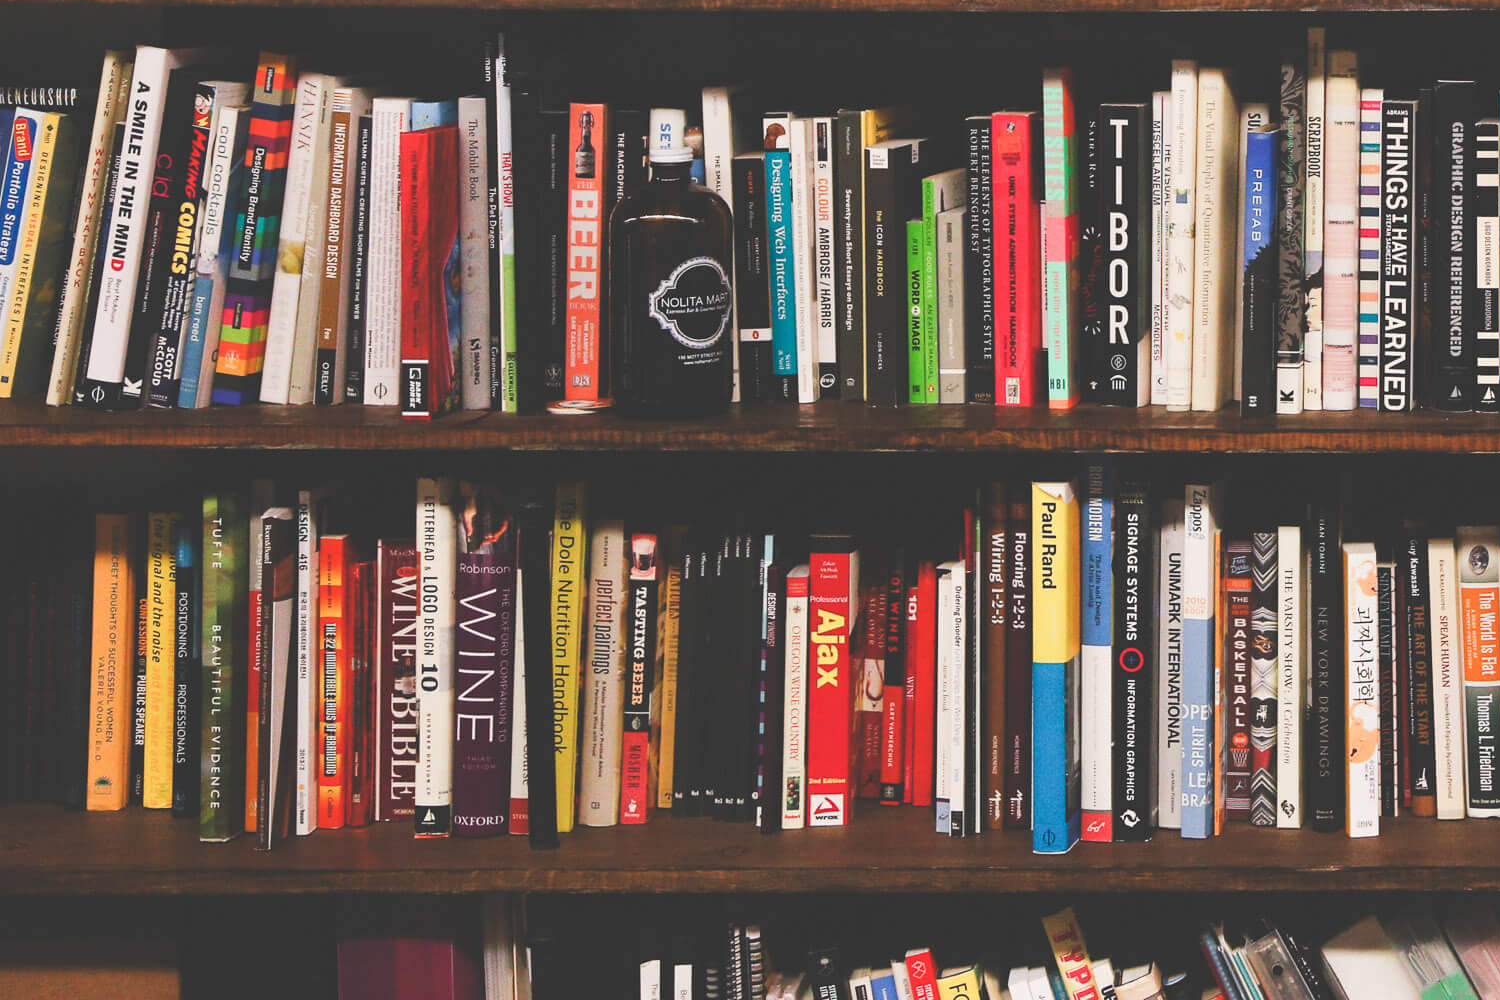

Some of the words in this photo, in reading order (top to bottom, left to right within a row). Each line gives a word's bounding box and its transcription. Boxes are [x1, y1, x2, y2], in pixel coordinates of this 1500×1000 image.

[138, 80, 151, 93] A
[15, 122, 29, 158] Brand
[133, 101, 149, 157] SMILE
[217, 125, 229, 162] cool
[332, 122, 346, 184] INFORMATION
[1308, 116, 1321, 178] SCRAPBOOK
[1451, 121, 1464, 189] GRAPHIC
[9, 160, 25, 211] Portfolio
[128, 160, 140, 181] IN
[184, 129, 208, 199] MAKING
[771, 159, 784, 223] Designing
[1153, 120, 1162, 207] MISCELLANEUM
[1385, 117, 1409, 212] THINGS
[118, 183, 136, 222] THE
[205, 166, 223, 237] cocktails
[328, 187, 343, 242] DASHBOARD
[1252, 168, 1264, 242] PREFAB
[1450, 193, 1463, 253] DESIGN
[0, 213, 16, 262] Strategy
[110, 226, 130, 273] MIND
[171, 201, 196, 275] COMICS
[569, 188, 598, 300] BEER
[774, 227, 785, 256] Web
[1109, 119, 1129, 346] TIBOR
[1391, 225, 1408, 277] HAVE
[325, 244, 339, 280] DESIGN
[776, 257, 788, 321] Interfaces
[912, 270, 921, 306] WORD
[662, 296, 703, 309] NOLITA
[706, 291, 729, 306] MART
[1450, 256, 1463, 358] REFERENCED
[151, 335, 169, 387] McCLOUD
[912, 314, 921, 353] IMAGE
[1384, 281, 1407, 414] LEARNED
[162, 346, 177, 380] SCOTT
[211, 517, 222, 570] TUFTE
[1041, 501, 1057, 536] Paul
[1127, 512, 1139, 573] SIGNAGE
[459, 562, 511, 576] Robinson
[559, 535, 576, 575] Dole
[989, 532, 1005, 583] Wiring
[1012, 532, 1027, 590] Flooring
[1041, 542, 1056, 590] Rand
[809, 595, 849, 603] Professional
[991, 586, 1005, 626] 1-2-3
[1012, 592, 1026, 630] 1-2-3
[1126, 576, 1138, 642] SYSTEMS
[1167, 552, 1182, 622] UNIMARK
[1232, 596, 1249, 604] THE
[178, 592, 188, 658] POSITIONING
[391, 576, 417, 662] WINE
[555, 580, 575, 661] Nutrition
[633, 586, 648, 660] TASTING
[1317, 607, 1328, 642] NEW
[210, 624, 221, 714] BEAUTIFUL
[456, 587, 497, 743] WINE
[811, 608, 845, 690] Ajax
[1233, 618, 1249, 728] BASKETBALL
[1318, 646, 1329, 688] YORK
[1352, 606, 1375, 705] 괴짜사회학
[550, 663, 570, 755] Handbook
[630, 662, 645, 706] BEER
[1167, 626, 1182, 750] INTERNATIONAL
[176, 684, 186, 764] PROFESSIONALS
[1125, 679, 1136, 748] INFORMATION
[1318, 695, 1330, 778] DRAWINGS
[209, 726, 221, 810] EVIDENCE
[391, 694, 417, 801] BIBLE
[626, 745, 641, 788] MOSHER
[1192, 725, 1206, 769] SPIRIT
[1125, 751, 1136, 802] GRAPHICS
[454, 815, 504, 827] OXFORD
